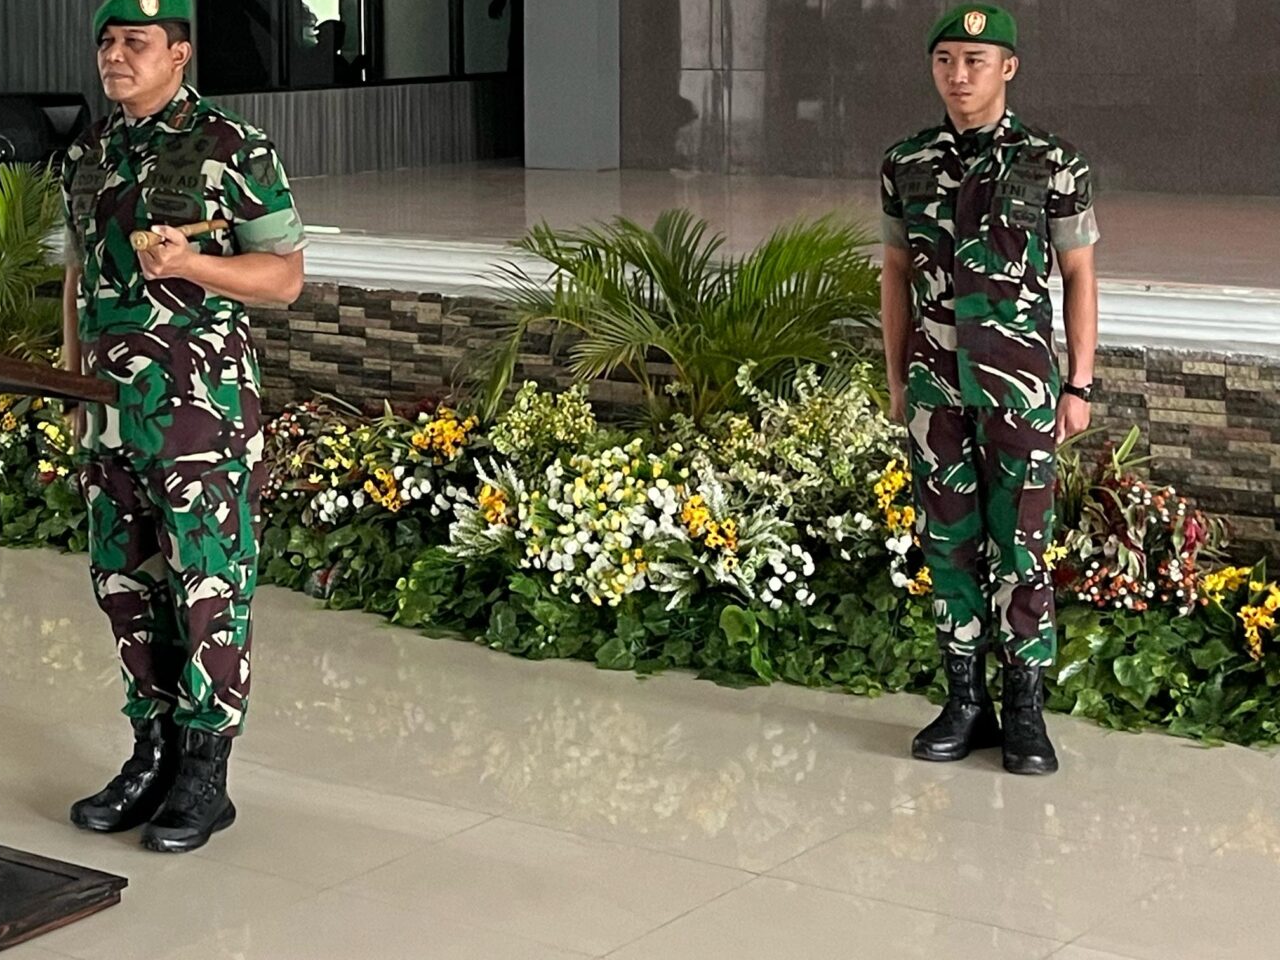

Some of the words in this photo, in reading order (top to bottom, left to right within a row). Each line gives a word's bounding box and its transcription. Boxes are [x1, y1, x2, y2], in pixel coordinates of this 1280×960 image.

[151, 172, 174, 186] TNI
[176, 175, 199, 188] AD
[1000, 182, 1027, 198] TNI
